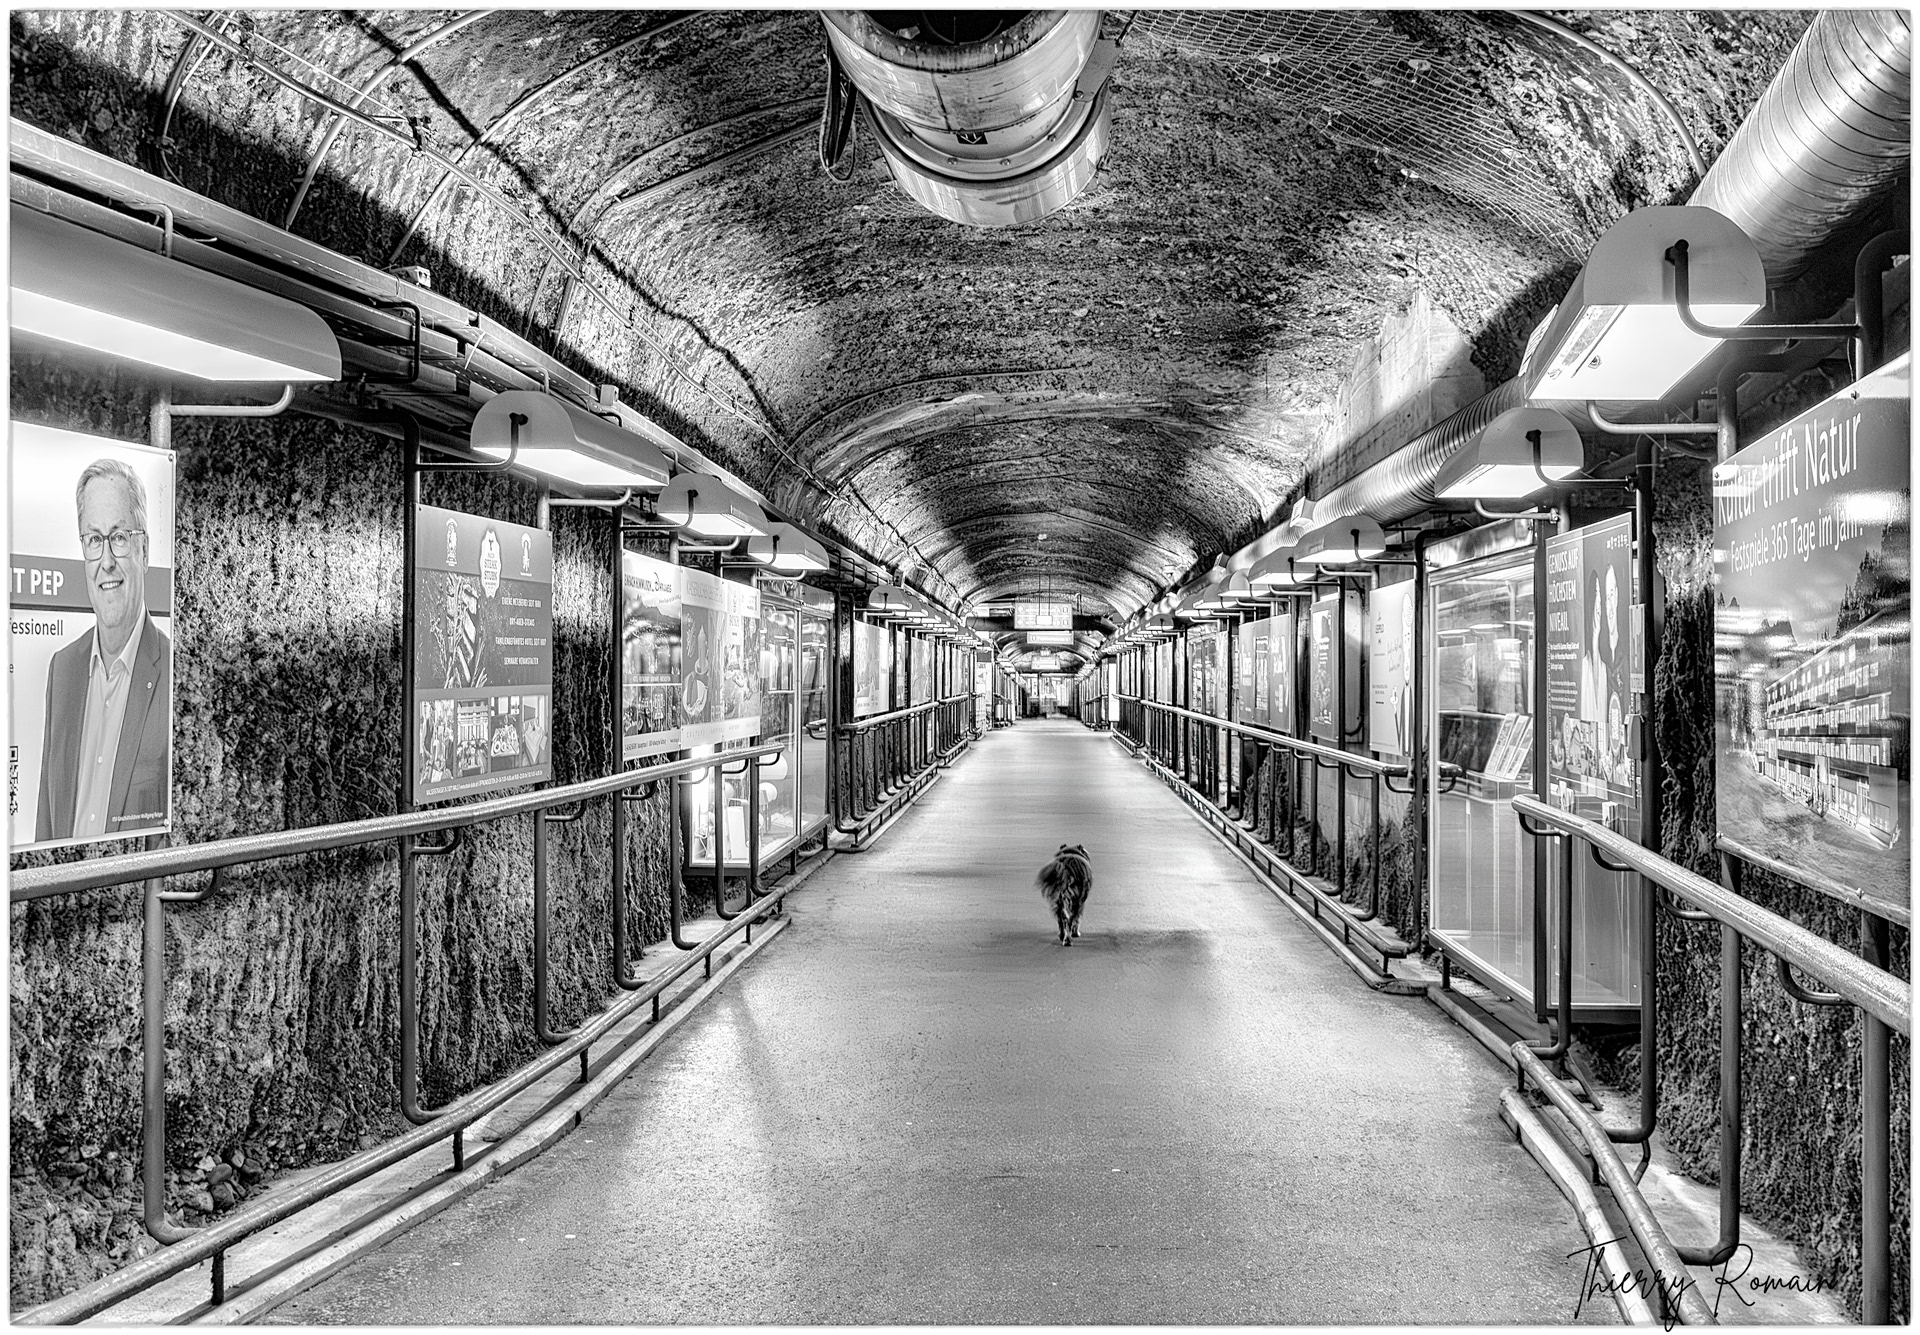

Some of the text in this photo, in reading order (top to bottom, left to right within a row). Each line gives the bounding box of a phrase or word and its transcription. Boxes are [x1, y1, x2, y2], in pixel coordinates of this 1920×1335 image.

[1718, 412, 1861, 528] Kultur trifft Natur
[1731, 527, 1769, 577] Festspiele
[1771, 520, 1788, 563] 365
[1790, 516, 1816, 562] Tage
[1818, 508, 1832, 548] im
[1548, 547, 1579, 574] GENUSS AUF
[30, 568, 65, 596] PEP
[1548, 579, 1577, 603] HÖCHSTEM
